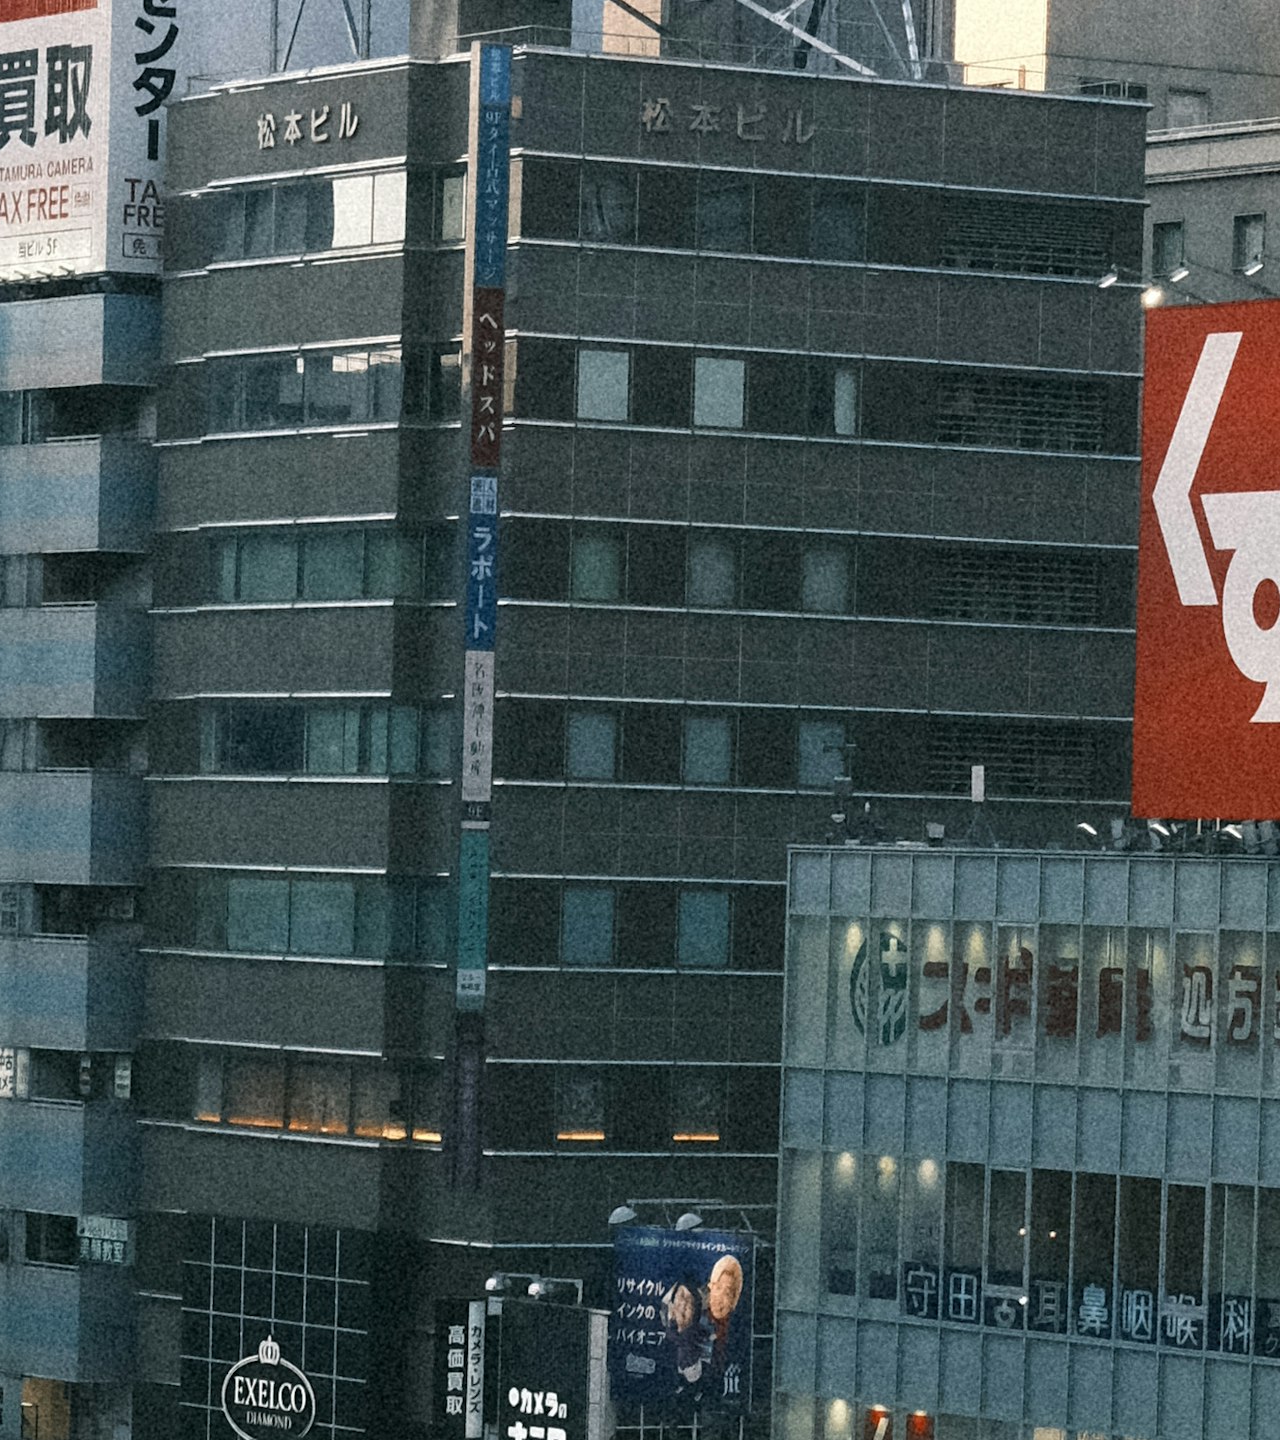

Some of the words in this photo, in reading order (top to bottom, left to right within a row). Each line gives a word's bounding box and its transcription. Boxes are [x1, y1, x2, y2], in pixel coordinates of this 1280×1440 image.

[257, 104, 360, 150] 松本ビル
[641, 98, 815, 146] 松本ビル
[47, 156, 94, 178] CAMERA
[27, 185, 70, 222] FREE
[445, 1324, 466, 1416] 高価買取
[233, 1375, 307, 1413] EXELCO
[246, 1410, 293, 1430] DIAMOND
